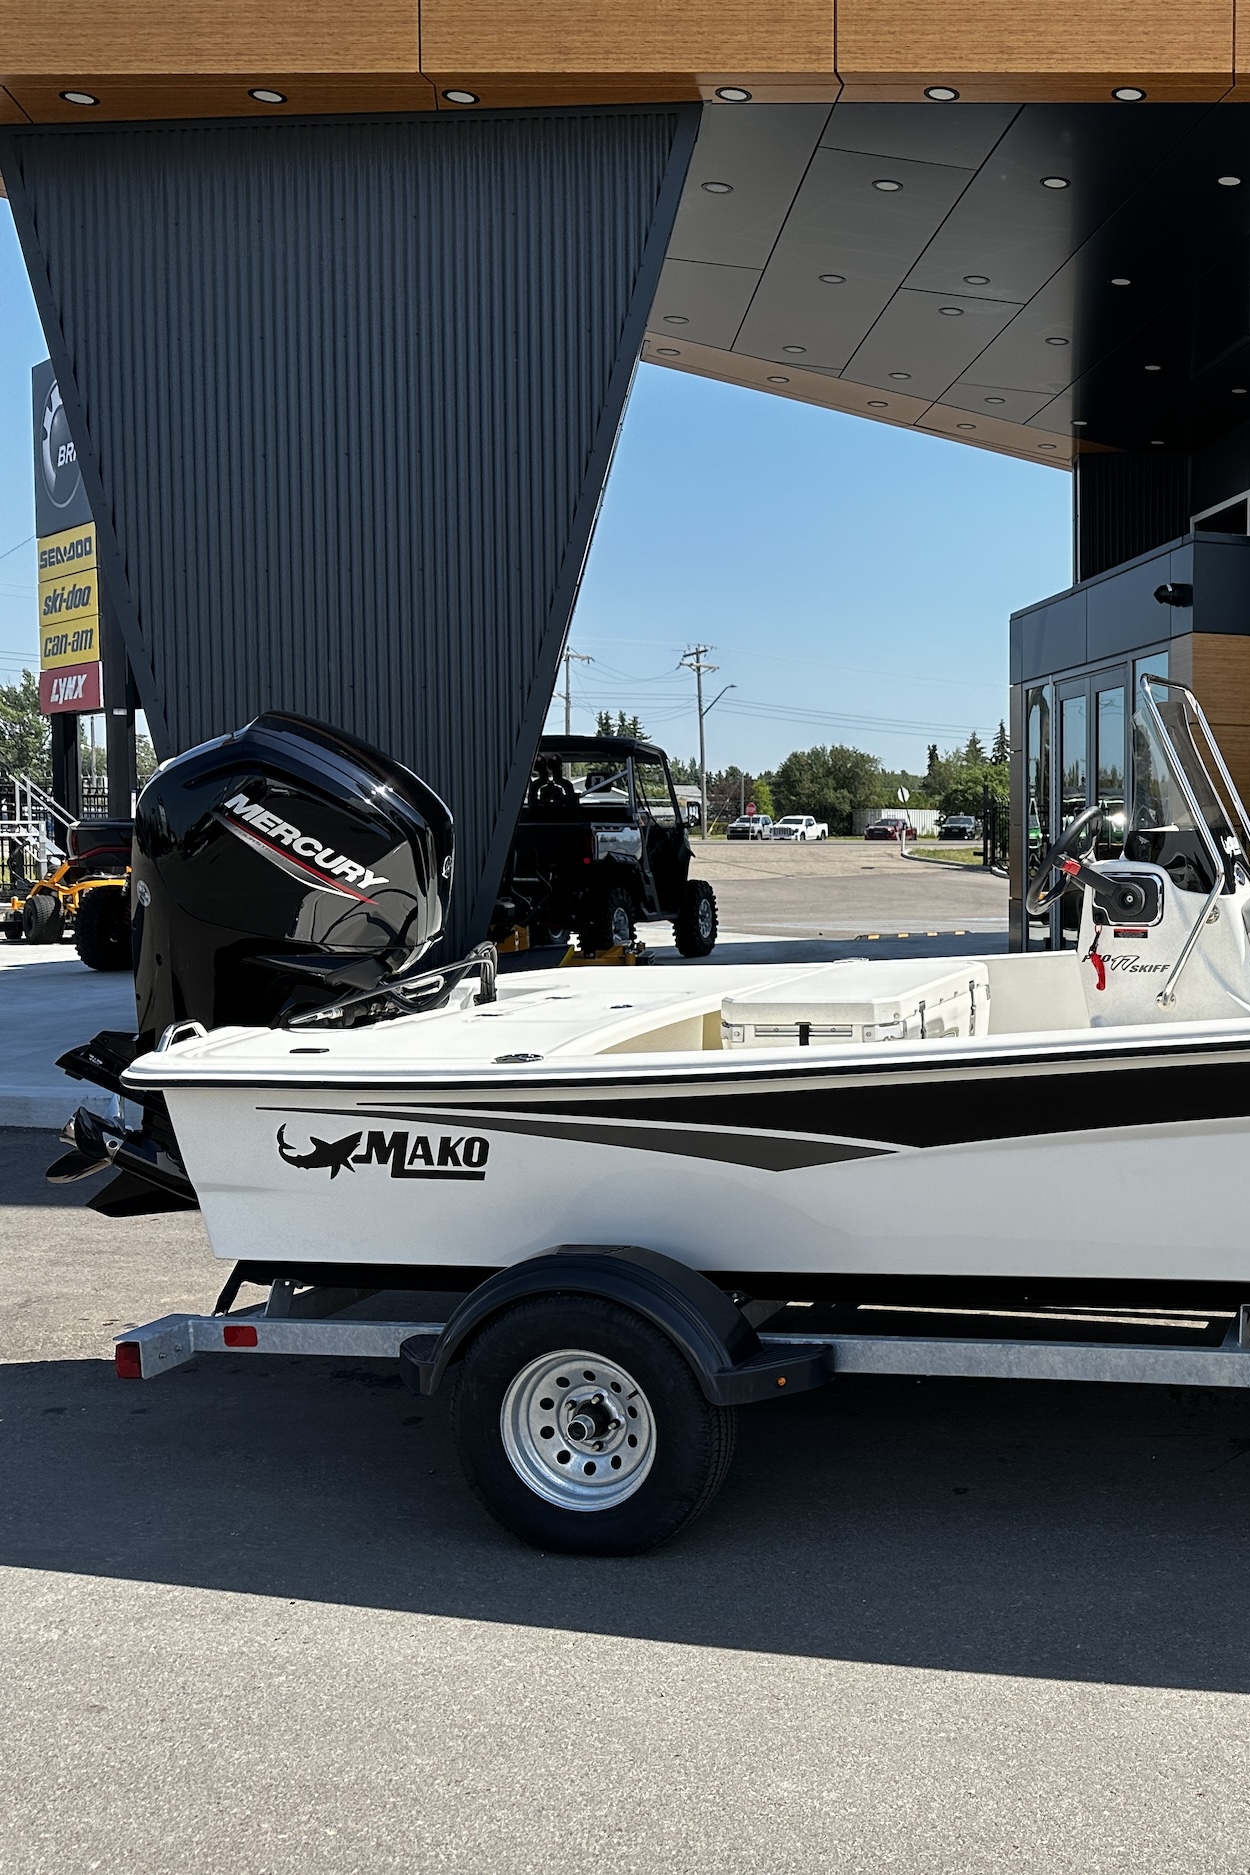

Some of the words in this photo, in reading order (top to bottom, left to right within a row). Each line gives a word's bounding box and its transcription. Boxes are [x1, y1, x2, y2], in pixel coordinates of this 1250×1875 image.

[42, 583, 92, 616] ski-doo
[43, 628, 94, 658] can-am
[50, 673, 87, 705] LYNX
[224, 793, 389, 889] MERCURY
[1081, 954, 1112, 963] PO
[1128, 964, 1170, 973] SKIFF
[350, 1131, 490, 1181] MAKO
